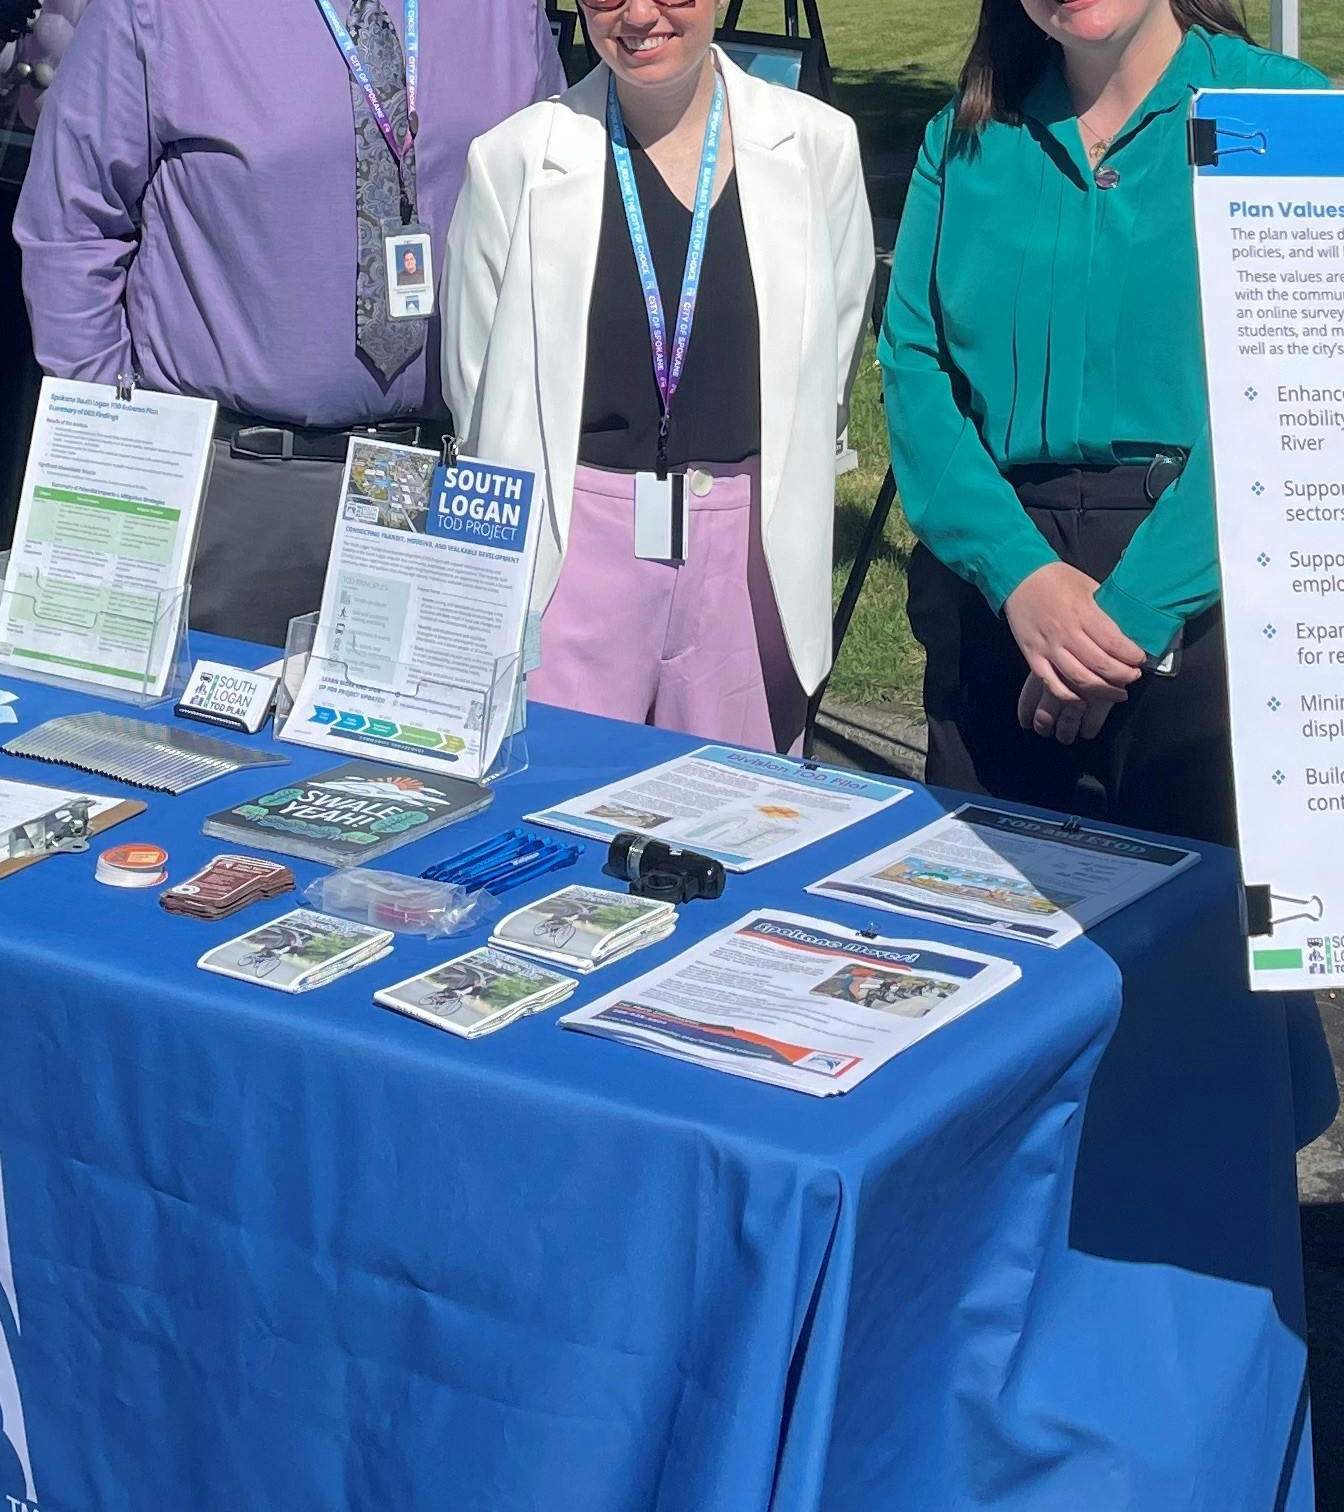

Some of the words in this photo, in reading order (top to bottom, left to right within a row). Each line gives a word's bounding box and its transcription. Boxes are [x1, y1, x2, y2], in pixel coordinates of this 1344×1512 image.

[1229, 201, 1273, 217] Plan
[1229, 227, 1255, 240] The
[1259, 227, 1288, 243] plan
[1291, 227, 1334, 240] values
[1232, 245, 1284, 261] policies,
[1289, 245, 1314, 258] and
[1317, 245, 1339, 258] will
[1281, 434, 1325, 451] River
[444, 467, 523, 501] SOUTH
[438, 491, 521, 527] LOGAN
[437, 514, 464, 535] TOD
[465, 519, 519, 543] PROJECT
[1297, 646, 1320, 664] for
[219, 675, 258, 695] SOUTH
[213, 689, 253, 708] LOGAN
[210, 701, 225, 712] TOD
[225, 704, 248, 717] PLAN
[726, 752, 793, 774] Division
[794, 768, 828, 782] TOD
[830, 777, 869, 792] Pilot
[278, 800, 376, 828] YEAH!
[297, 789, 404, 820] SWALE
